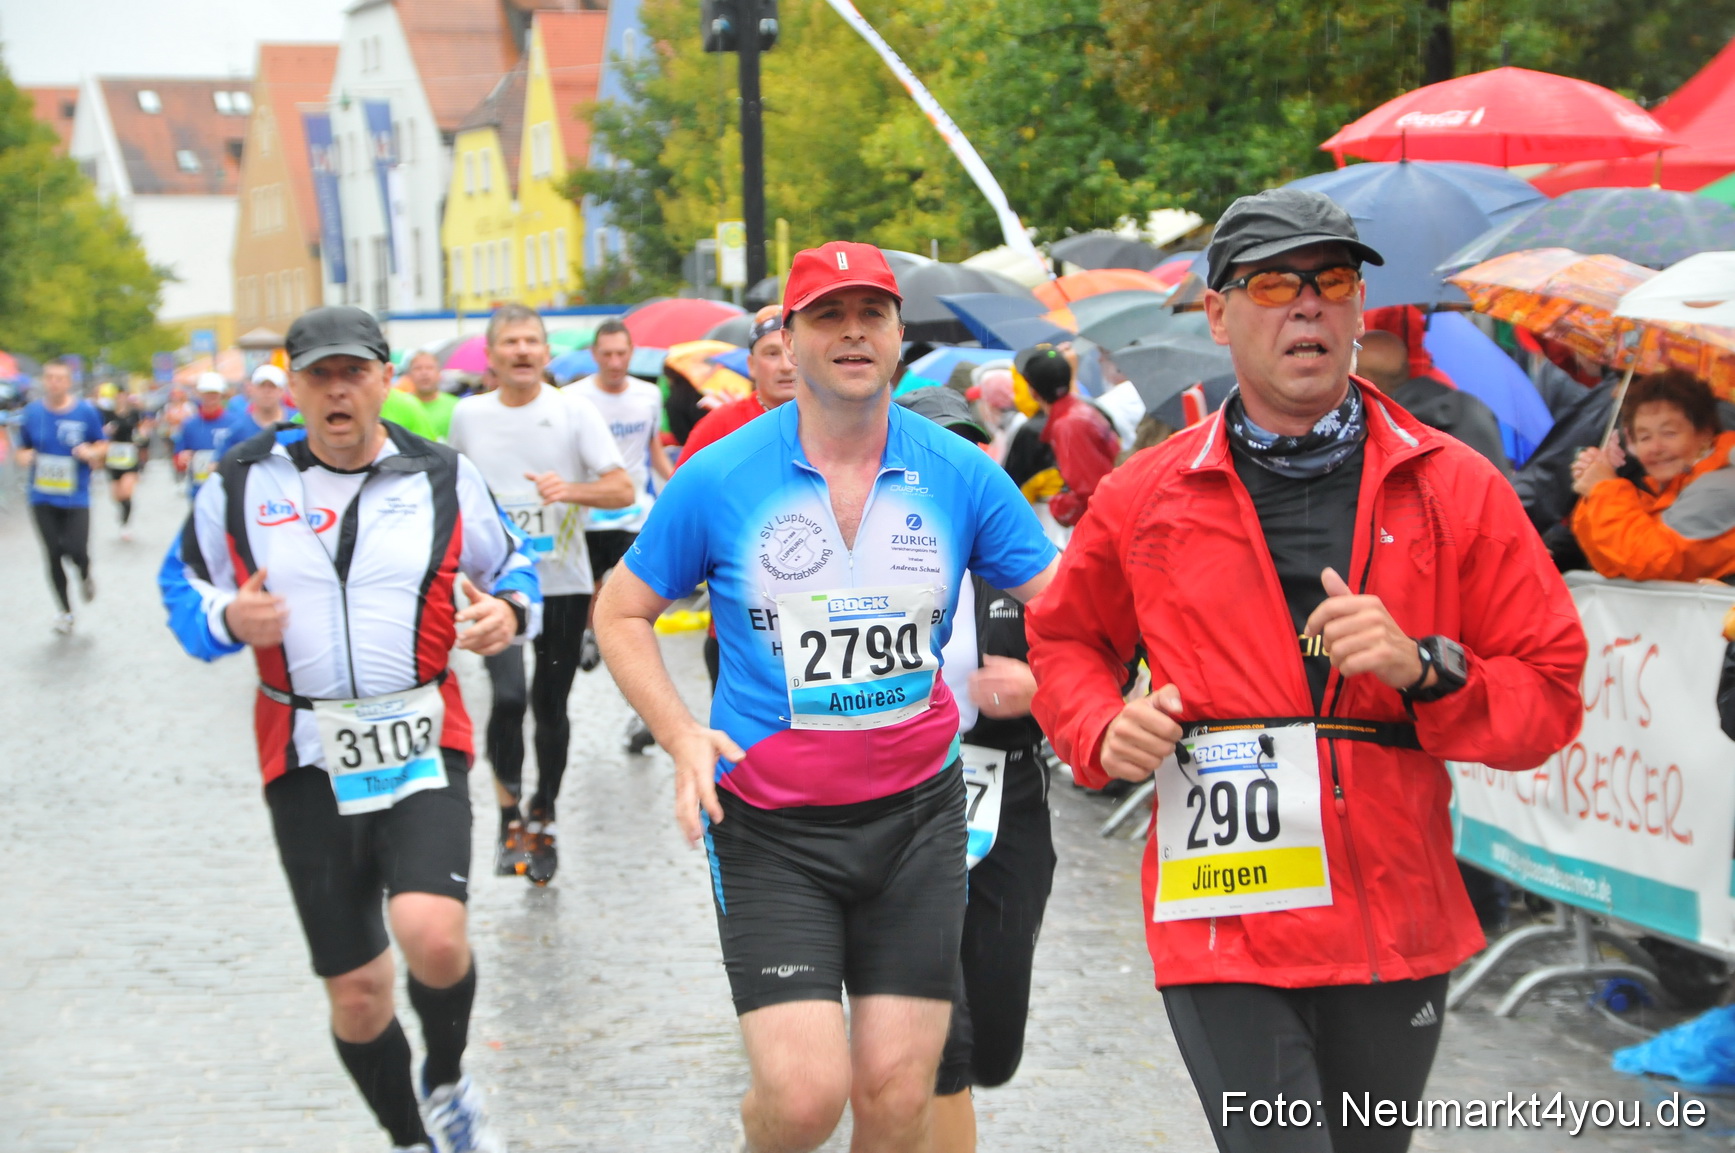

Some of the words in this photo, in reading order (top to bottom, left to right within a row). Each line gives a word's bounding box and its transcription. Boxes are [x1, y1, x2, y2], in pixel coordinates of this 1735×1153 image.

[760, 521, 775, 540] SV
[775, 513, 822, 535] Lupburg
[779, 537, 804, 561] LUPBURG
[891, 535, 937, 546] ZURICH
[759, 548, 833, 580] Radsportabteilung
[918, 565, 940, 573] Schmid
[828, 595, 889, 613] BOCK
[800, 623, 923, 682] 2790
[829, 687, 906, 712] Andreas
[336, 716, 432, 769] 3103
[1194, 742, 1257, 764] BOCK
[1186, 778, 1280, 851] 290
[1192, 863, 1268, 893] Jürgen
